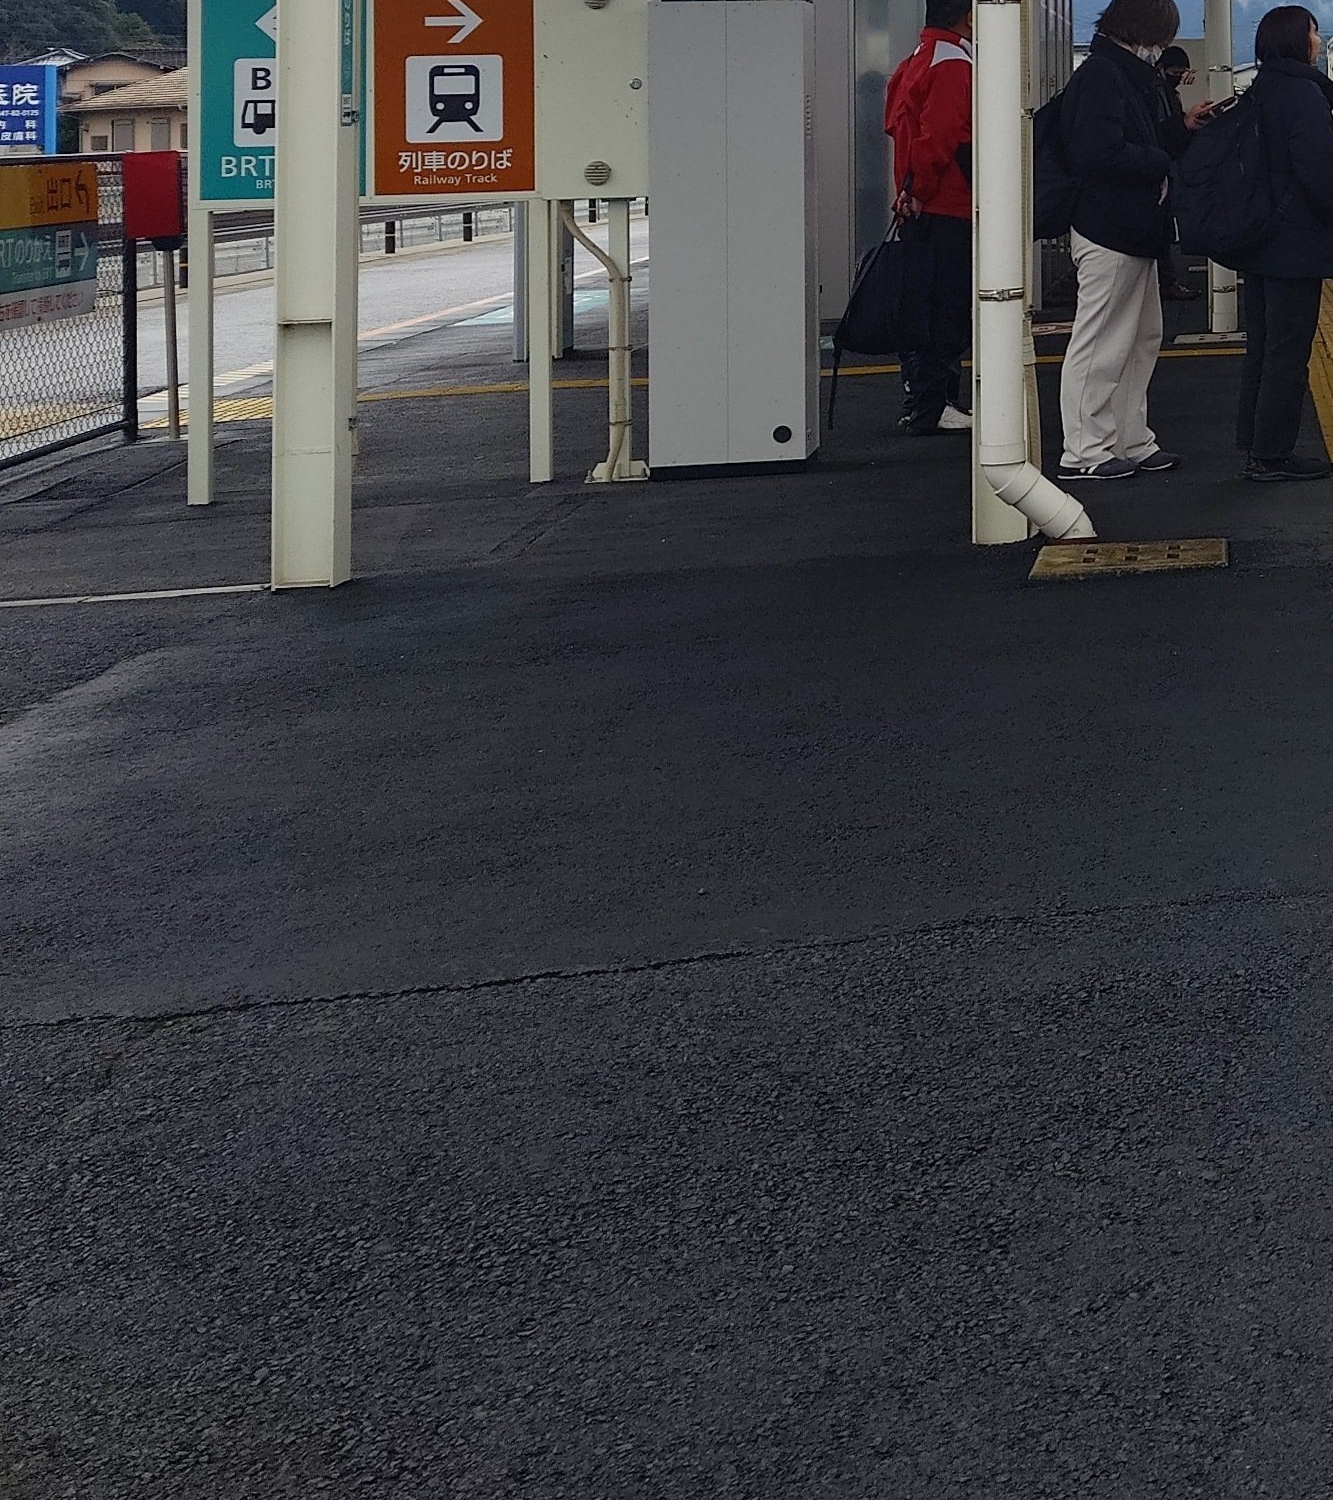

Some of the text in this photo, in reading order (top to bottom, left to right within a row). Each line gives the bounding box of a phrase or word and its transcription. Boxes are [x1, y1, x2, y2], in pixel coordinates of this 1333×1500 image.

[398, 151, 513, 172] 列車のりば
[256, 179, 274, 189] BR
[414, 173, 498, 186] Railway Track
[46, 177, 73, 213] 出口
